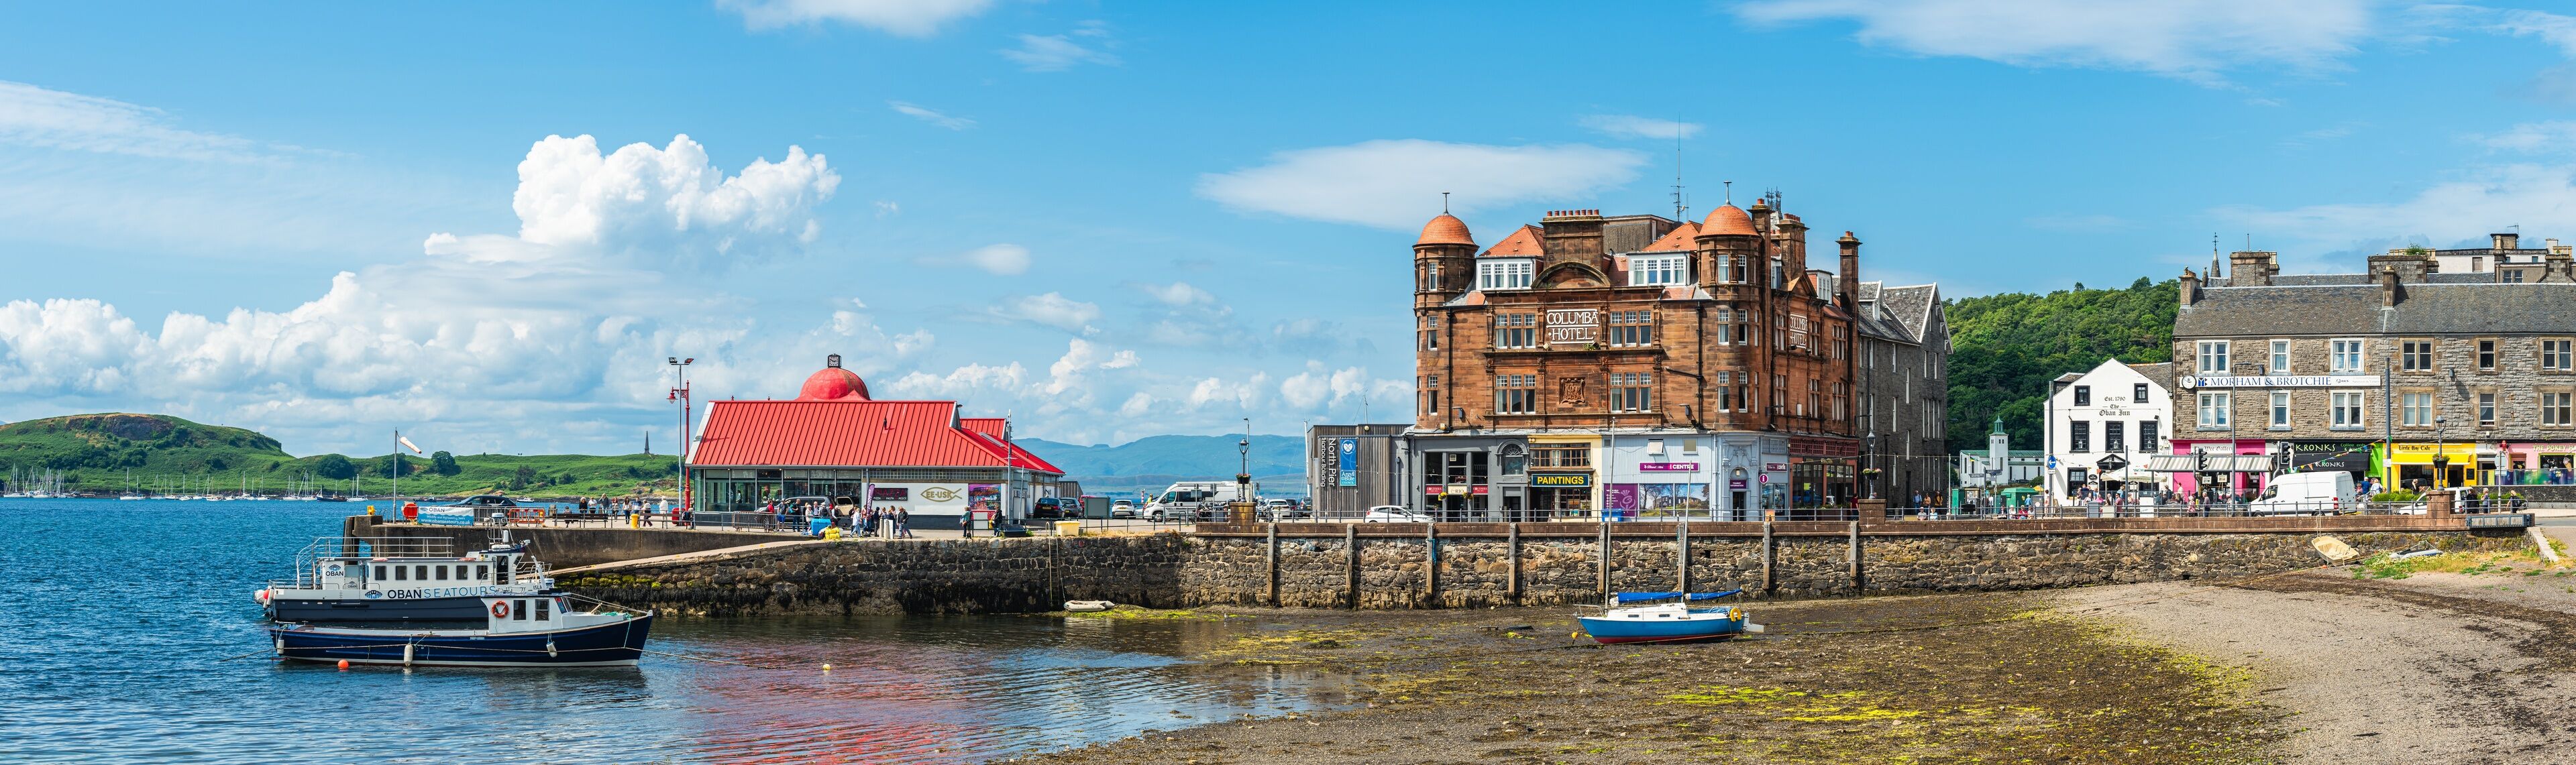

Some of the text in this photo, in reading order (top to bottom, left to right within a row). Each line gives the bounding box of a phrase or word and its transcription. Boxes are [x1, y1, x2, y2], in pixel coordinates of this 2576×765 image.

[1547, 312, 1599, 325] COLUMBA
[1552, 328, 1594, 341] HOTEL
[1791, 332, 1806, 346] HOTEL
[2211, 377, 2331, 386] MORHAM & BROTCHIE
[1328, 437, 1336, 486] North Pier
[1538, 476, 1584, 484] PAINTINGS
[387, 589, 421, 599] OBAN
